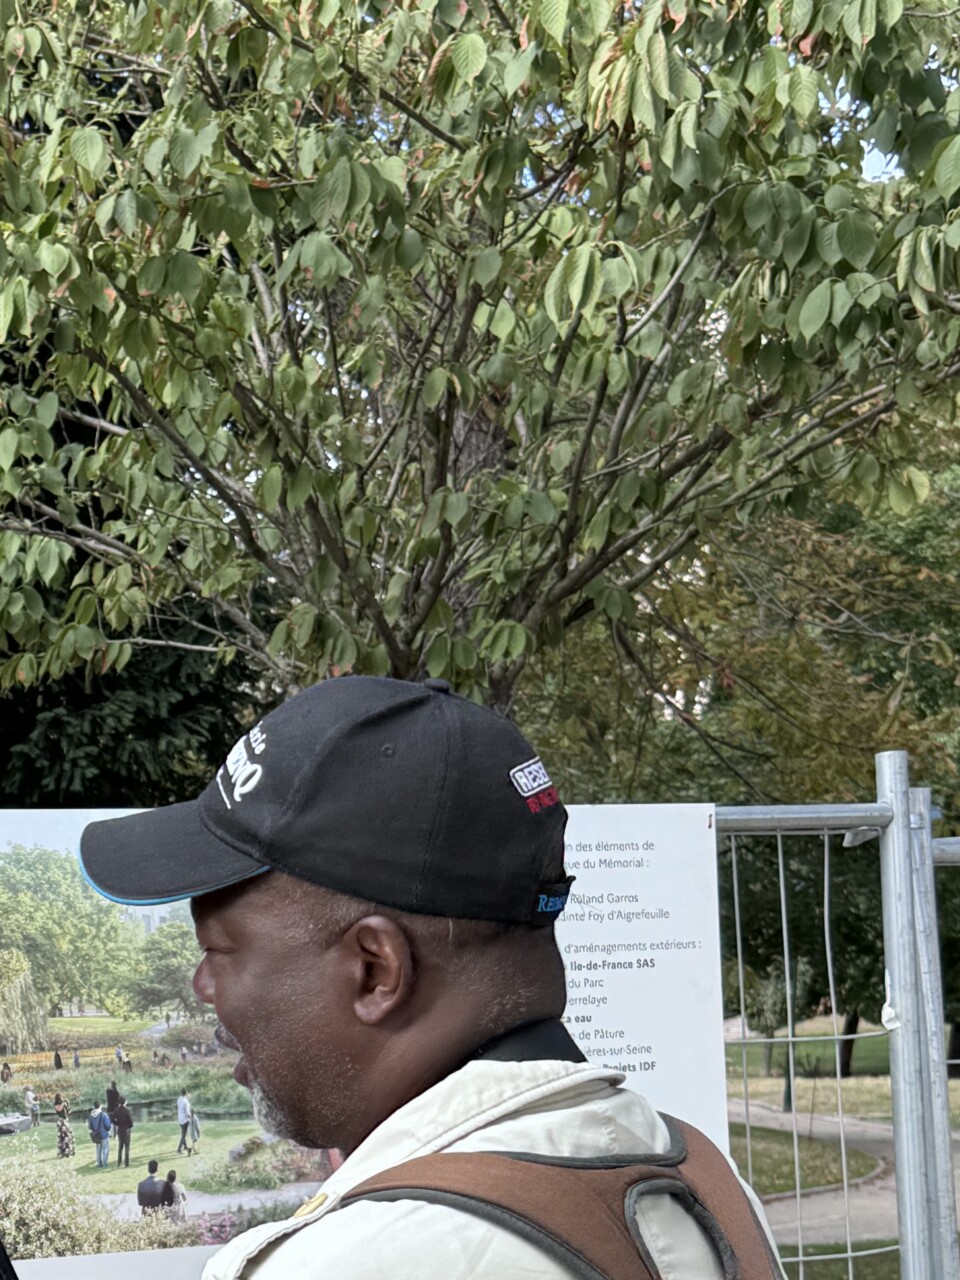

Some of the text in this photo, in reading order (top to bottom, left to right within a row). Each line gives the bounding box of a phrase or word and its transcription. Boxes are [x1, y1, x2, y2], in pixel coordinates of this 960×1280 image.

[576, 842, 593, 852] des
[595, 840, 640, 852] éléments
[642, 840, 655, 851] de
[583, 858, 596, 869] du
[570, 893, 604, 904] Roland
[606, 892, 639, 904] Garros
[588, 910, 605, 924] Foy
[564, 942, 648, 956] d'aménagements
[650, 939, 697, 950] extérieurs
[636, 958, 656, 969] SAS
[568, 978, 604, 989] du Parc
[568, 994, 608, 1007] errelaye
[574, 1014, 592, 1023] eau
[578, 1030, 591, 1040] de
[640, 1061, 656, 1072] IDF
